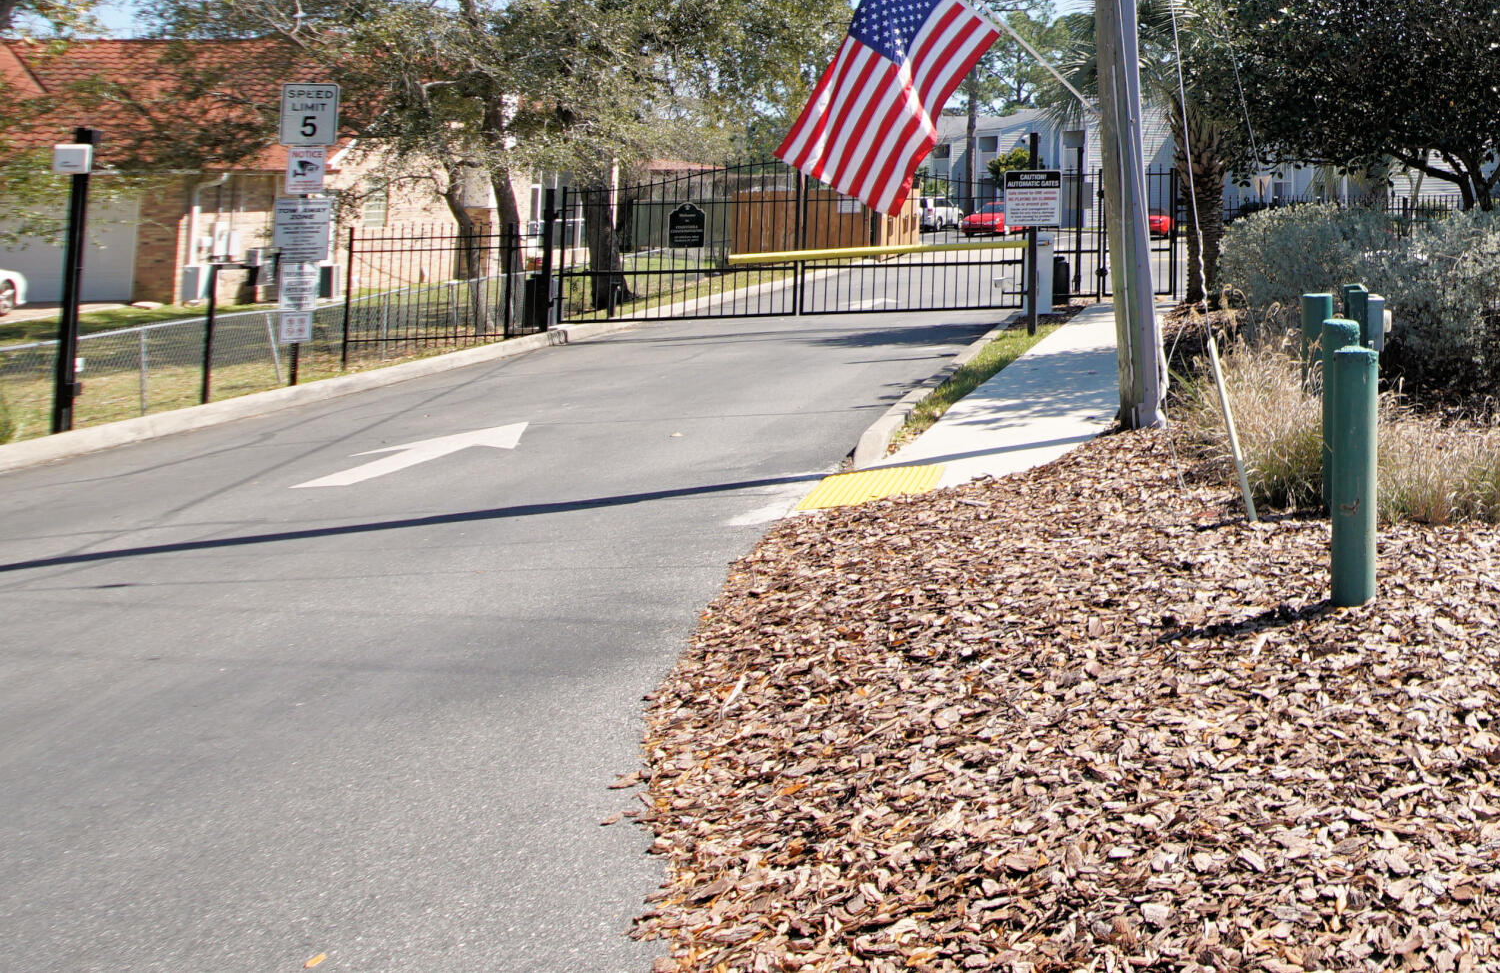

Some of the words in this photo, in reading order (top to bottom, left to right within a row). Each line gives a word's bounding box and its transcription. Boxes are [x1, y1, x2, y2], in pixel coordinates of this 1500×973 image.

[287, 89, 334, 99] SPEED
[291, 102, 327, 112] LIMIT
[300, 115, 317, 138] 5
[292, 150, 323, 159] NOTICE
[1007, 180, 1041, 188] AUTOMATIC
